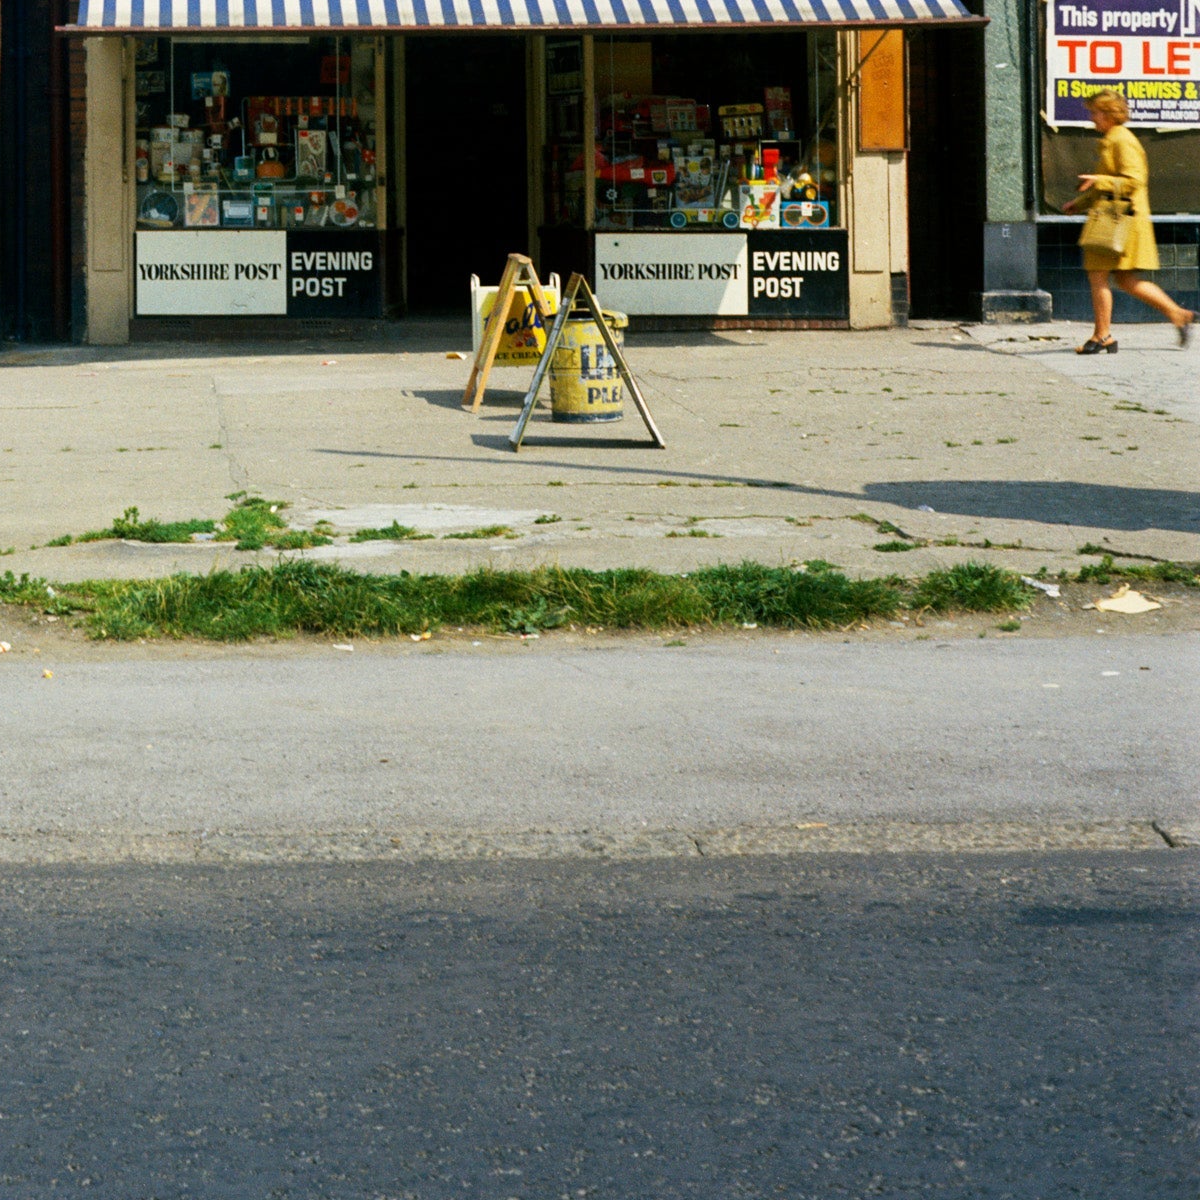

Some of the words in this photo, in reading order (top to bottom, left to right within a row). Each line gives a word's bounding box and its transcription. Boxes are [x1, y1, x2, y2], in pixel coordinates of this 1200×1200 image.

[1058, 4, 1098, 28] This
[1101, 7, 1178, 33] property
[1057, 39, 1122, 74] TO
[1057, 80, 1068, 97] R
[1127, 81, 1182, 99] NEWISS
[1184, 82, 1198, 99] &
[1160, 110, 1199, 120] BRADFORD
[291, 251, 373, 271] EVENING
[752, 251, 840, 271] EVENING
[139, 263, 229, 281] YORKSHIRE
[234, 263, 282, 281] POST
[600, 263, 695, 281] YORKSHIRE
[698, 263, 741, 280] POST
[291, 277, 347, 297] POST
[753, 277, 804, 298] POST
